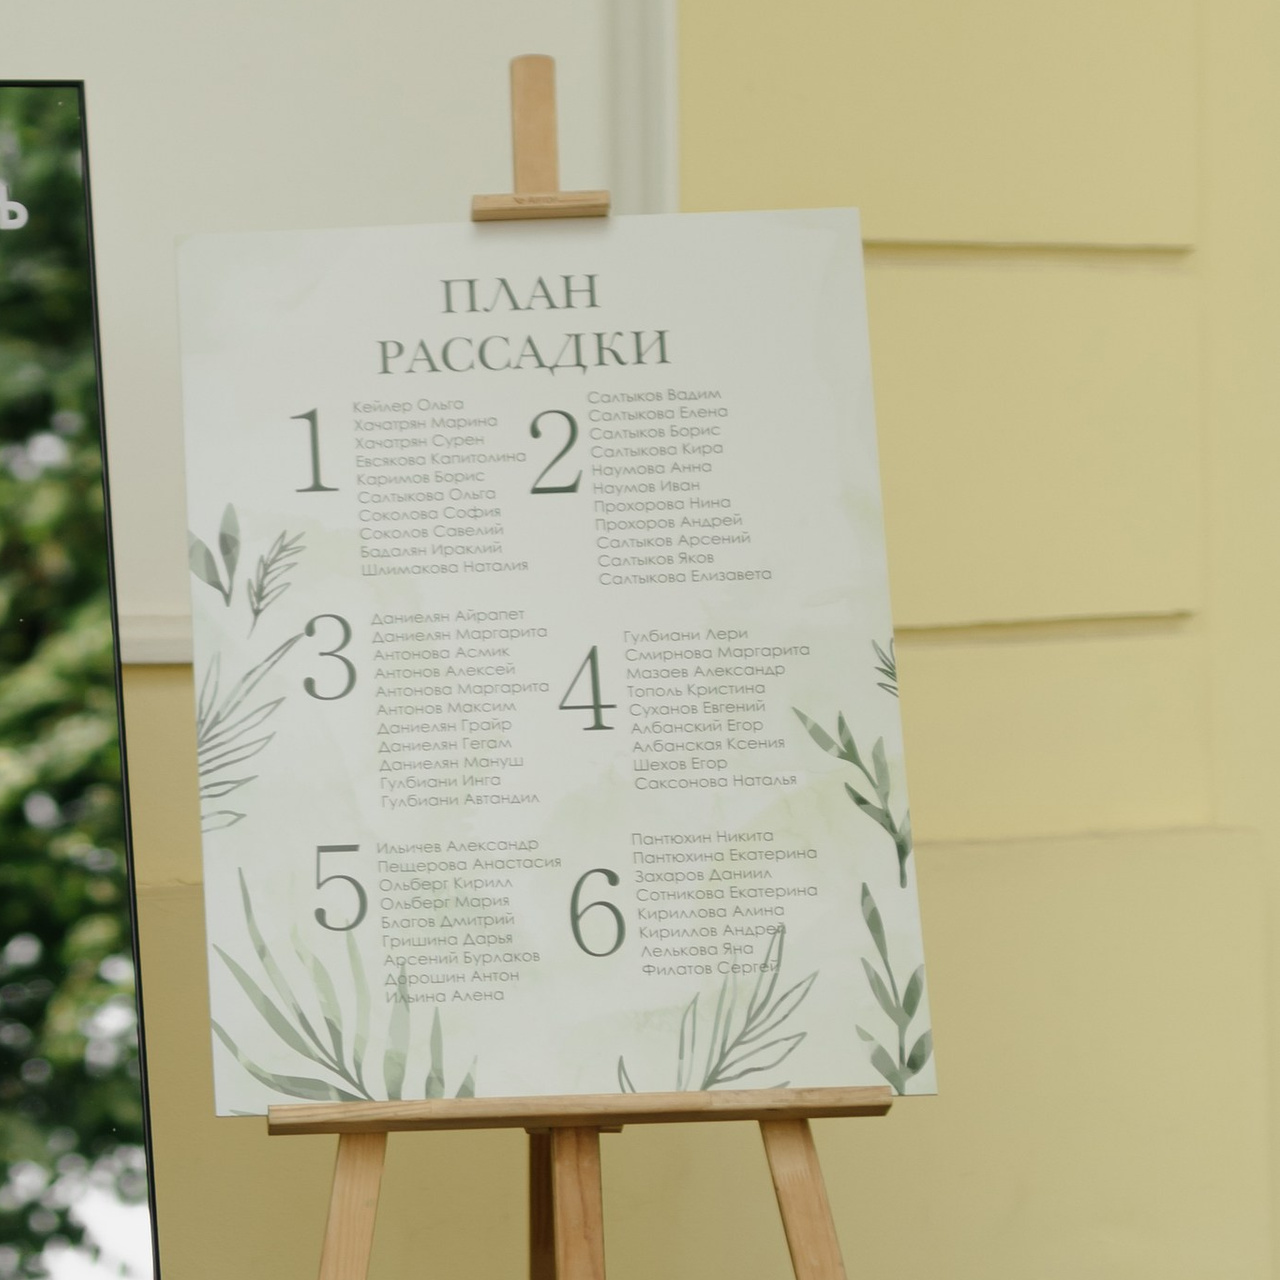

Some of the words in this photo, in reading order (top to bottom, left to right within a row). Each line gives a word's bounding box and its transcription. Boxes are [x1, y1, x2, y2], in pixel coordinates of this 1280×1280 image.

[440, 274, 601, 313] ПЛАН
[376, 330, 671, 376] РАССАДКИ
[587, 391, 663, 404] Салтыков
[668, 389, 721, 402] Вадим
[353, 400, 412, 415] Кейлер
[418, 399, 464, 411] Ольга
[589, 409, 675, 422] Салтыкова
[680, 407, 728, 419] Елена
[354, 419, 426, 433] Хачатрян
[431, 416, 498, 429] Марина
[590, 428, 665, 440] Салтыков
[671, 425, 721, 439] Борис
[290, 408, 339, 492] 1
[355, 437, 427, 450] Хачатрян
[432, 435, 484, 449] Сурен
[530, 409, 583, 494] 2
[590, 446, 678, 458] Салтыкова
[683, 444, 723, 457] Кира
[357, 456, 426, 468] Евсякова
[431, 452, 526, 464] Капитолина
[592, 464, 665, 478] Наумова
[671, 462, 712, 473] Анна
[358, 474, 430, 487] Каримов
[435, 471, 485, 485] Борис
[594, 482, 655, 496] Наумов
[660, 480, 700, 492] Иван
[358, 492, 444, 504] Салтыкова
[449, 489, 496, 501] Ольга
[595, 500, 685, 514] Прохорова
[690, 497, 731, 509] Нина
[359, 510, 438, 522] Соколова
[443, 506, 501, 520] София
[596, 519, 675, 532] Прохоров
[681, 514, 743, 529] Андрей
[360, 528, 428, 540] Соколов
[434, 524, 504, 538] Савелий
[597, 537, 672, 549] Салтыков
[678, 531, 751, 547] Арсений
[361, 546, 427, 559] Бадалян
[432, 542, 502, 556] Ираклий
[361, 563, 458, 576] Шлимакова
[464, 560, 529, 573] Наталия
[598, 555, 674, 567] Салтыков
[679, 553, 714, 564] Яков
[599, 573, 686, 585] Салтыкова
[692, 569, 772, 582] Елизавета
[371, 613, 449, 625] Даниелян
[455, 610, 525, 623] Айрапет
[372, 631, 451, 644] Даниелян
[456, 627, 547, 641] Маргарита
[624, 630, 700, 644] Гулбиани
[705, 628, 748, 641] Лери
[303, 614, 357, 700] 3
[374, 649, 450, 661] Антонова
[455, 647, 510, 658] Асмик
[625, 648, 712, 662] Смирнова
[718, 645, 810, 658] Маргарита
[374, 667, 440, 679] Антонов
[445, 663, 515, 676] Алексей
[627, 667, 688, 679] Мазаев
[694, 664, 785, 677] Александр
[375, 685, 452, 697] Антонова
[458, 681, 549, 695] Маргарита
[559, 645, 617, 731] 4
[628, 685, 683, 698] Тополь
[688, 684, 766, 696] Кристина
[377, 704, 442, 716] Антонов
[448, 701, 516, 713] Максим
[629, 703, 698, 717] Суханов
[704, 700, 766, 714] Евгений
[377, 723, 456, 735] Даниелян
[462, 718, 512, 732] Грайр
[631, 720, 722, 734] Албанский
[728, 719, 764, 732] Егор
[378, 741, 457, 754] Даниелян
[463, 738, 512, 750] Гегам
[633, 740, 722, 753] Албанская
[728, 738, 785, 750] Ксения
[380, 759, 458, 772] Даниелян
[464, 756, 524, 770] Мануш
[634, 759, 687, 771] Шехов
[692, 757, 727, 771] Егор
[381, 776, 458, 791] Гулбиани
[463, 775, 501, 786] Инга
[635, 777, 728, 790] Саксонова
[733, 775, 797, 786] Наталья
[382, 794, 458, 810] Гулбиани
[464, 793, 539, 805] Автандил
[632, 833, 711, 846] Пантюхин
[717, 830, 774, 843] Никита
[377, 842, 440, 854] Ильичев
[447, 839, 538, 852] Александр
[634, 851, 724, 864] Пантюхина
[730, 848, 817, 861] Екатерина
[378, 860, 467, 874] Пещерова
[473, 857, 562, 869] Анастасия
[635, 870, 704, 883] Захаров
[709, 869, 772, 881] Даниил
[314, 844, 367, 932] 5
[379, 878, 449, 892] Ольберг
[454, 877, 513, 890] Кирилл
[636, 888, 724, 902] Сотникова
[731, 885, 818, 899] Екатерина
[380, 897, 450, 910] Ольберг
[455, 896, 510, 908] Мария
[570, 868, 626, 957] 6
[638, 907, 727, 921] Кириллова
[732, 905, 784, 917] Алина
[382, 916, 435, 929] Благов
[440, 913, 514, 928] Дмитрий
[640, 926, 718, 940] Кириллов
[723, 921, 786, 937] Андрей
[383, 934, 458, 948] Гришина
[463, 932, 513, 946] Дарья
[641, 945, 718, 957] Лелькова
[723, 943, 753, 955] Яна
[384, 952, 458, 966] Арсений
[464, 951, 540, 965] Бурлаков
[642, 963, 712, 976] Филатов
[718, 959, 780, 976] Сергей
[385, 973, 465, 986] Дорошин
[471, 971, 519, 982] Антон
[386, 991, 446, 1003] Ильина
[451, 990, 504, 1001] Алена
